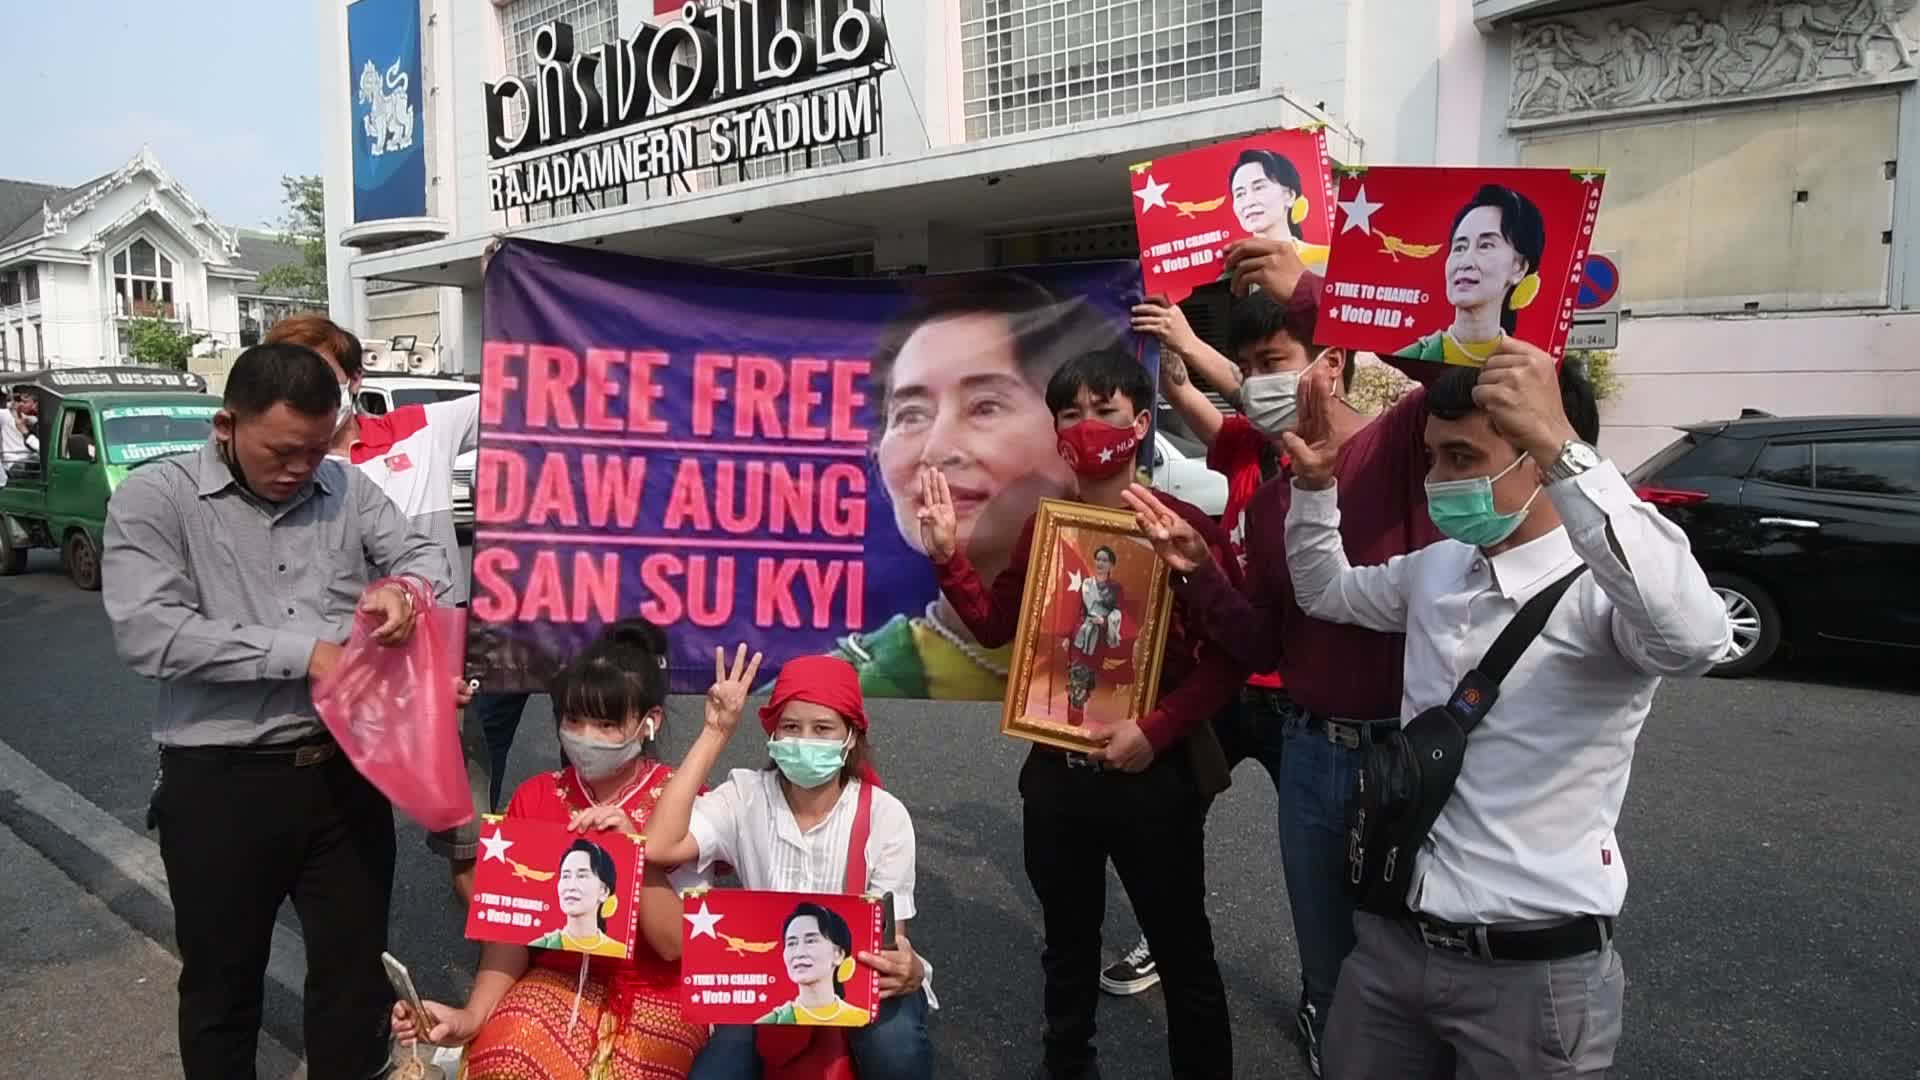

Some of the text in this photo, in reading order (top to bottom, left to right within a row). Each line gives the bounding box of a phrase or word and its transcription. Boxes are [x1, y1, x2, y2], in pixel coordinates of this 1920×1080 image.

[489, 83, 874, 211] RAJADAMNERN STADIUM
[1582, 187, 1599, 235] AUNG
[1172, 240, 1185, 252] TO
[1570, 250, 1584, 283] SAN
[1334, 282, 1421, 304] TIME TO CHANGE
[1341, 304, 1402, 328] Vote NLD
[1559, 298, 1572, 331] SUU
[183, 373, 198, 387] 2
[481, 341, 871, 442] FREE FREE
[475, 447, 867, 538] DAW AUNG
[472, 547, 865, 630] SAN SU KYI
[501, 895, 512, 907] TO
[716, 974, 729, 985] TO
[730, 973, 768, 985] CHANGE
[702, 990, 731, 1004] Vote
